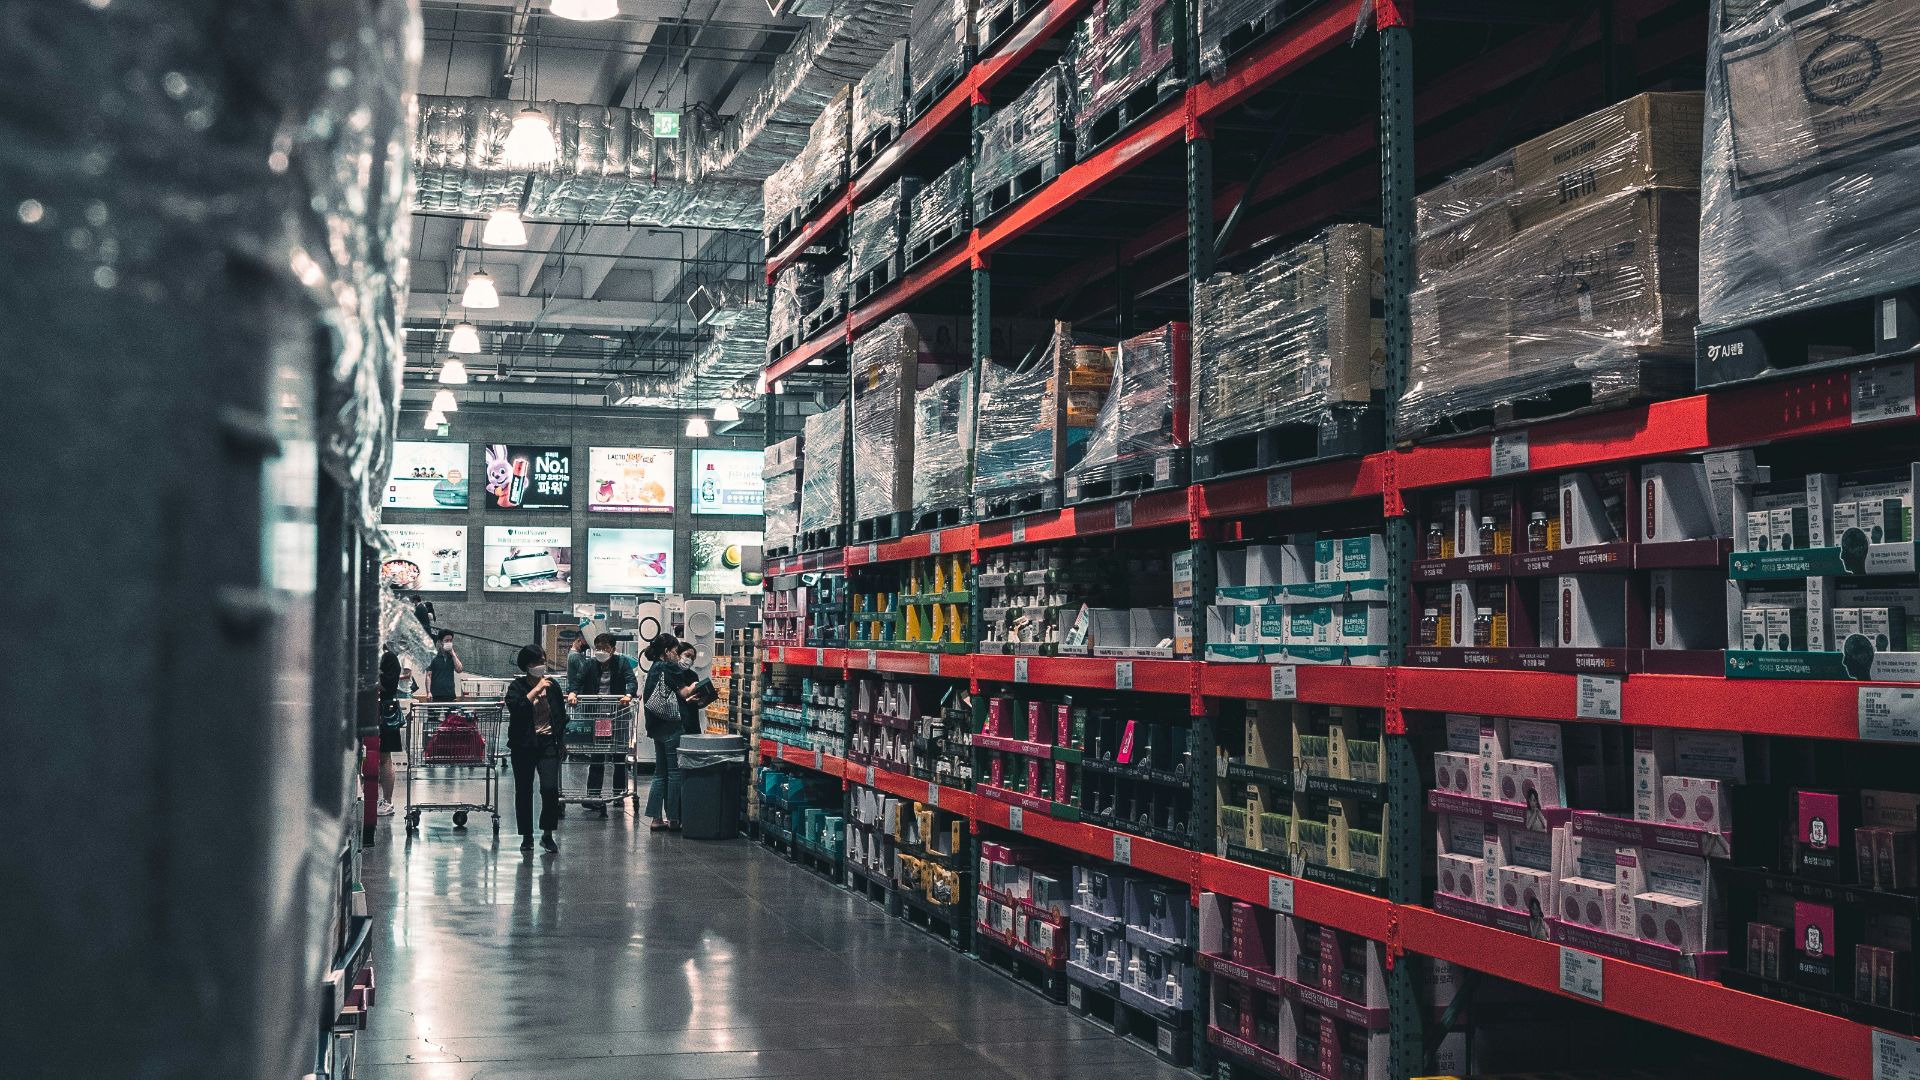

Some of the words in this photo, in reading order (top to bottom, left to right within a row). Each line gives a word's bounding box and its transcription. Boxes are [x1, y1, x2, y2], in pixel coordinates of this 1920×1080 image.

[1830, 73, 1865, 92] Home
[1721, 341, 1744, 358] AJ렌탈
[535, 456, 569, 474] No.1
